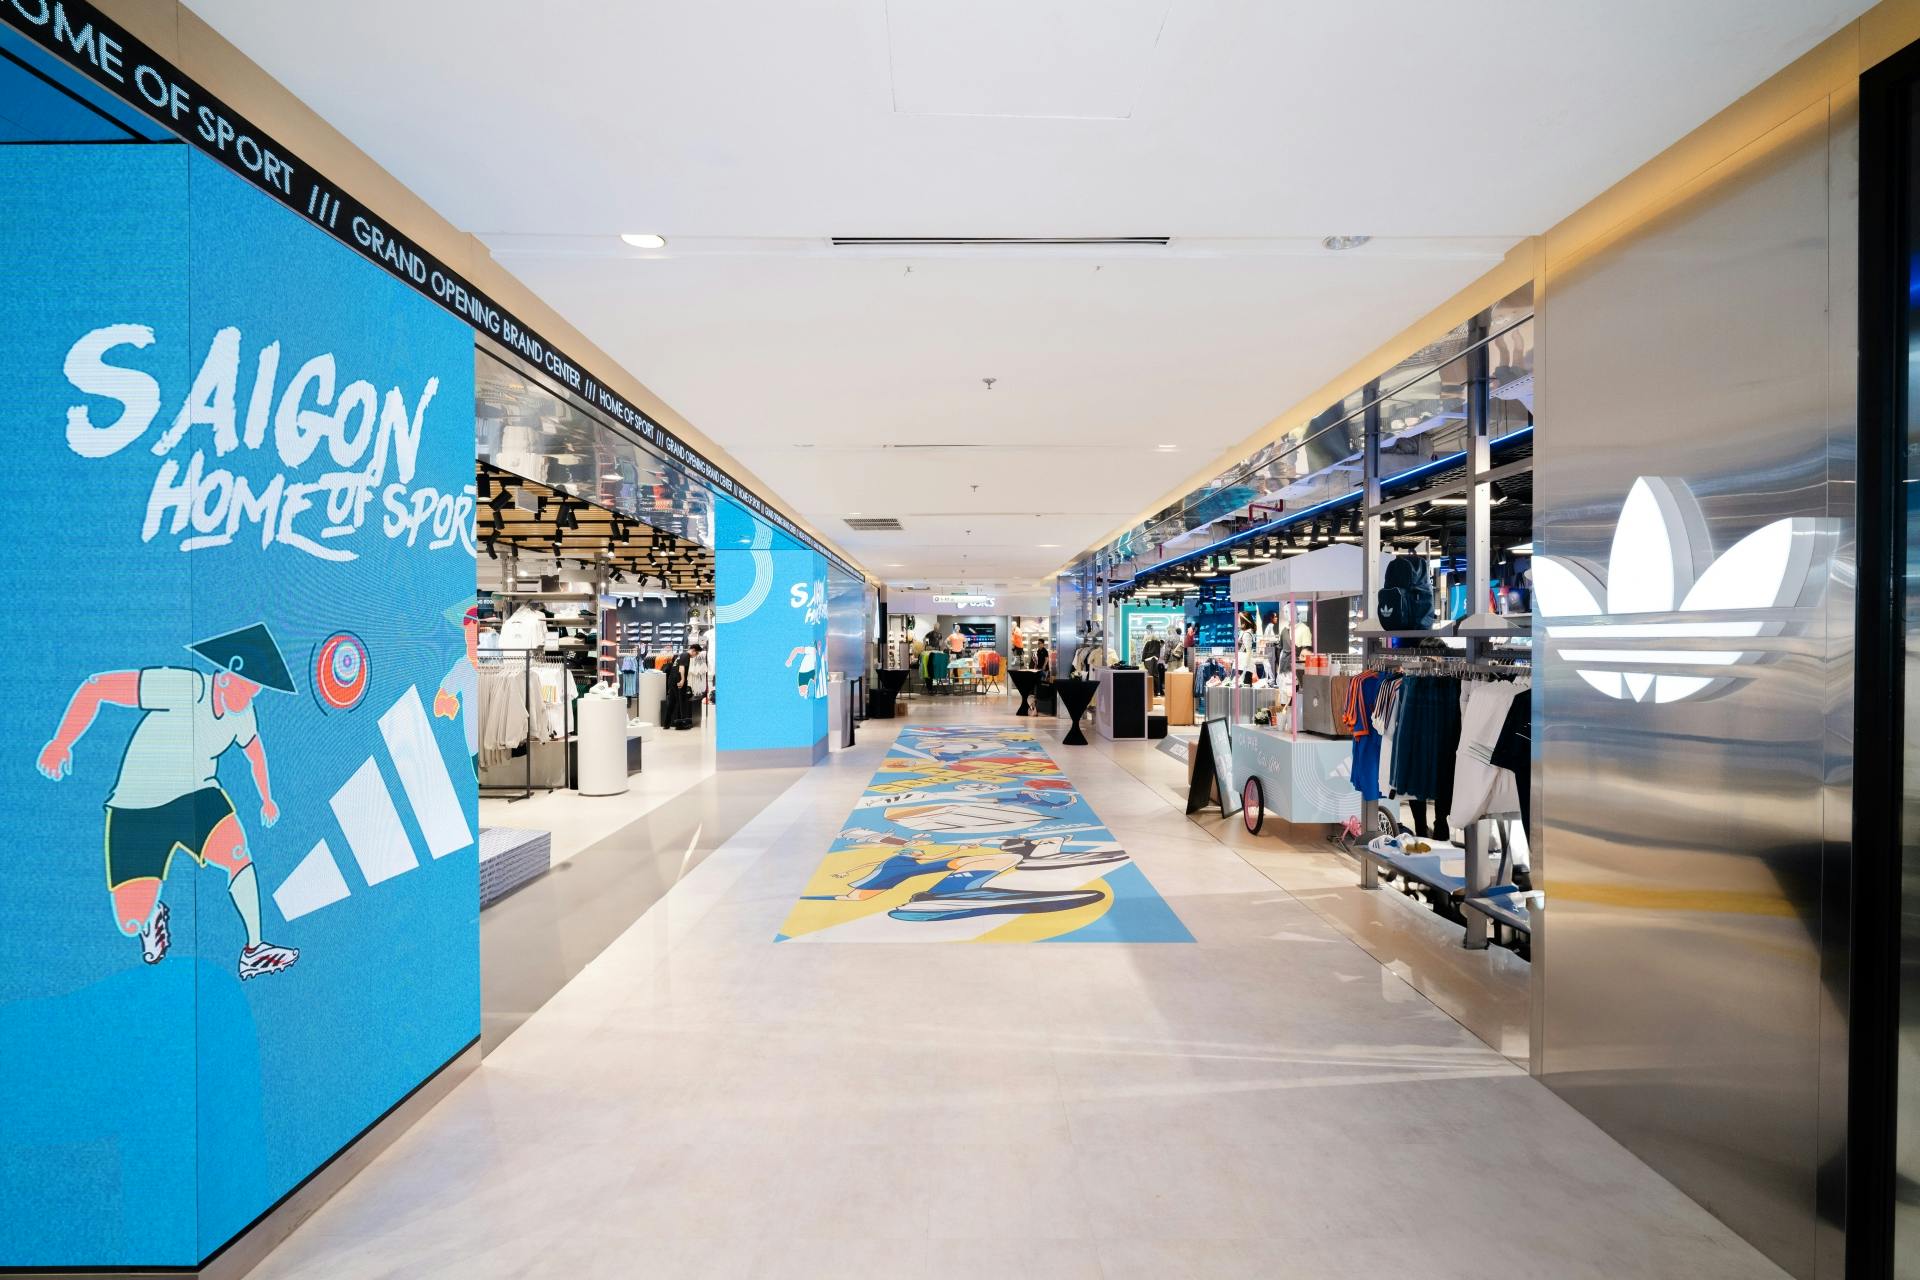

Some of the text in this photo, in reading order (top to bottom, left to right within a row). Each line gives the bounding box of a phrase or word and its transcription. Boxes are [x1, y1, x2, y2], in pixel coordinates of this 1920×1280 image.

[10, 0, 124, 83] OME
[134, 65, 190, 120] OF
[197, 106, 294, 195] SPORT
[352, 216, 426, 284] GRAND
[431, 271, 500, 333] OPENING
[503, 318, 543, 364] BRAND
[545, 351, 581, 391] CENTER
[600, 388, 623, 420] HOME
[624, 407, 635, 426] OF
[634, 414, 654, 440] SPORT
[666, 436, 685, 460] GRAND
[685, 450, 706, 474] OPENING
[706, 464, 719, 483] BRAND
[64, 323, 440, 485] SAIGON
[141, 448, 359, 562] HOME
[319, 470, 378, 538] OF
